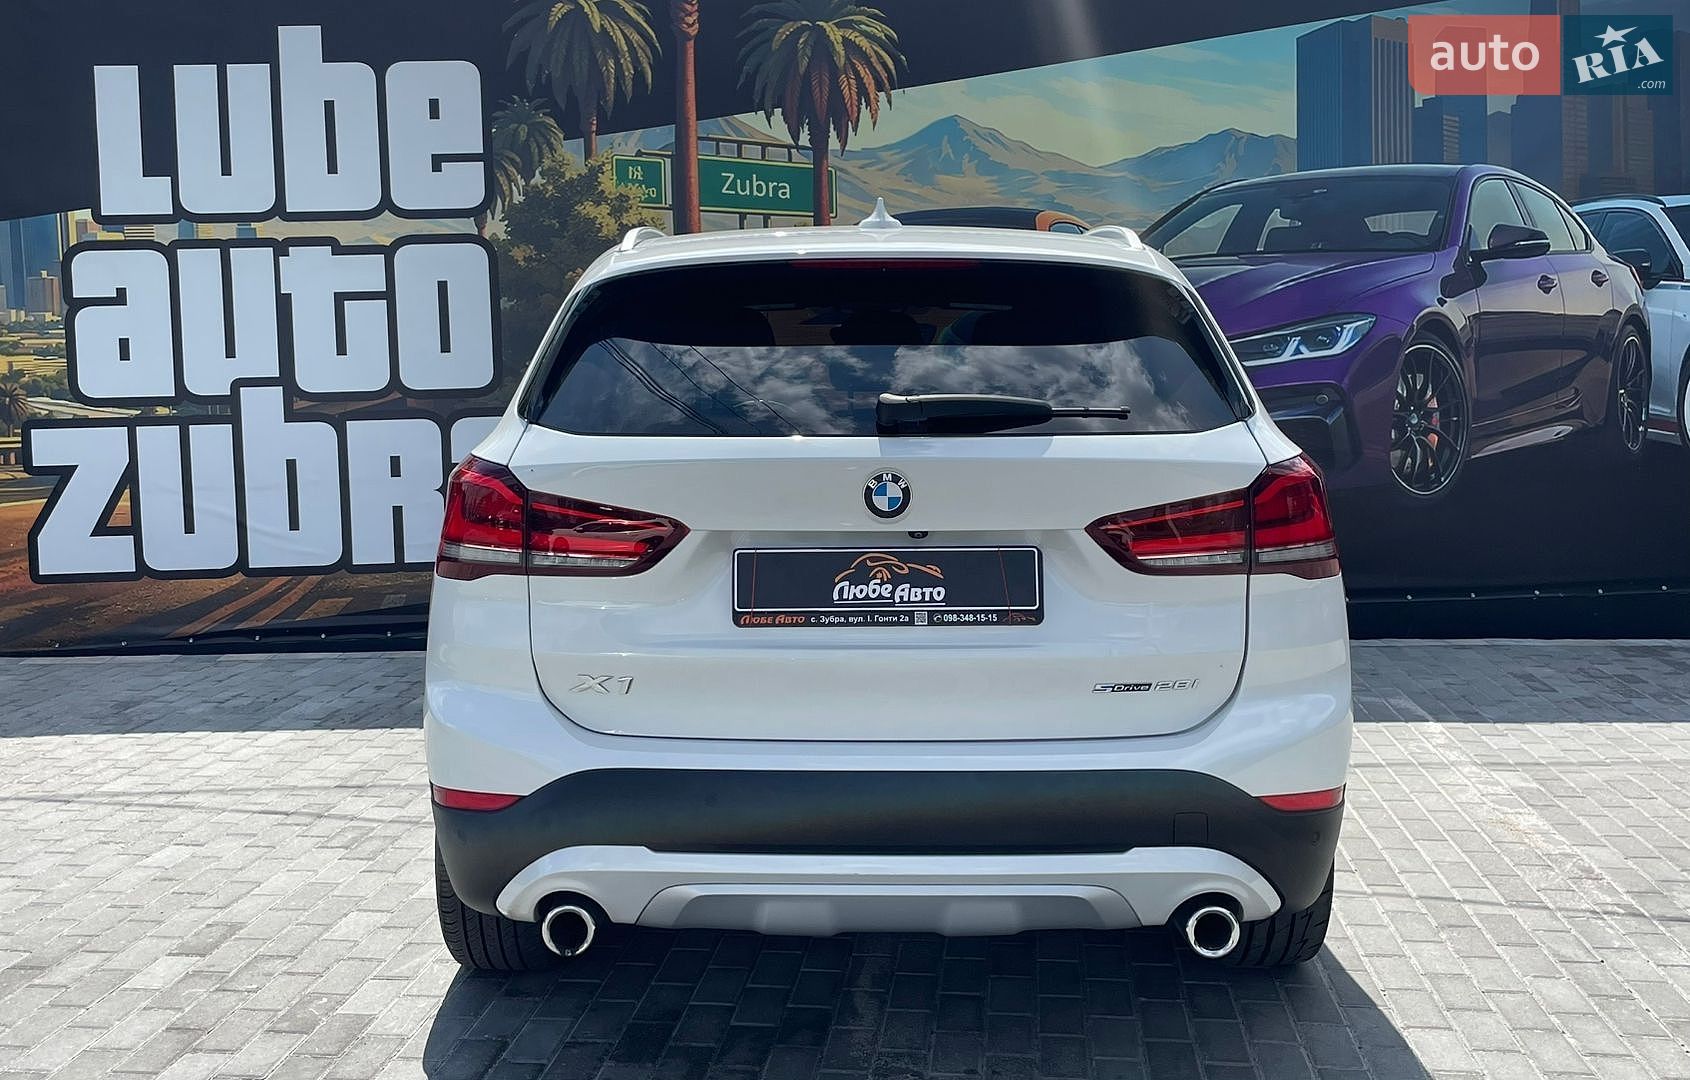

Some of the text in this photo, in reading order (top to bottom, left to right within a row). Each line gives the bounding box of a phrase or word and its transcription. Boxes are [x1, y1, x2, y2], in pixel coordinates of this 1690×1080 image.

[721, 172, 791, 200] Zubra
[867, 473, 908, 489] BMW
[832, 579, 946, 603] Любе Авто
[943, 613, 998, 622] 098-348-15-15
[568, 674, 634, 694] X1
